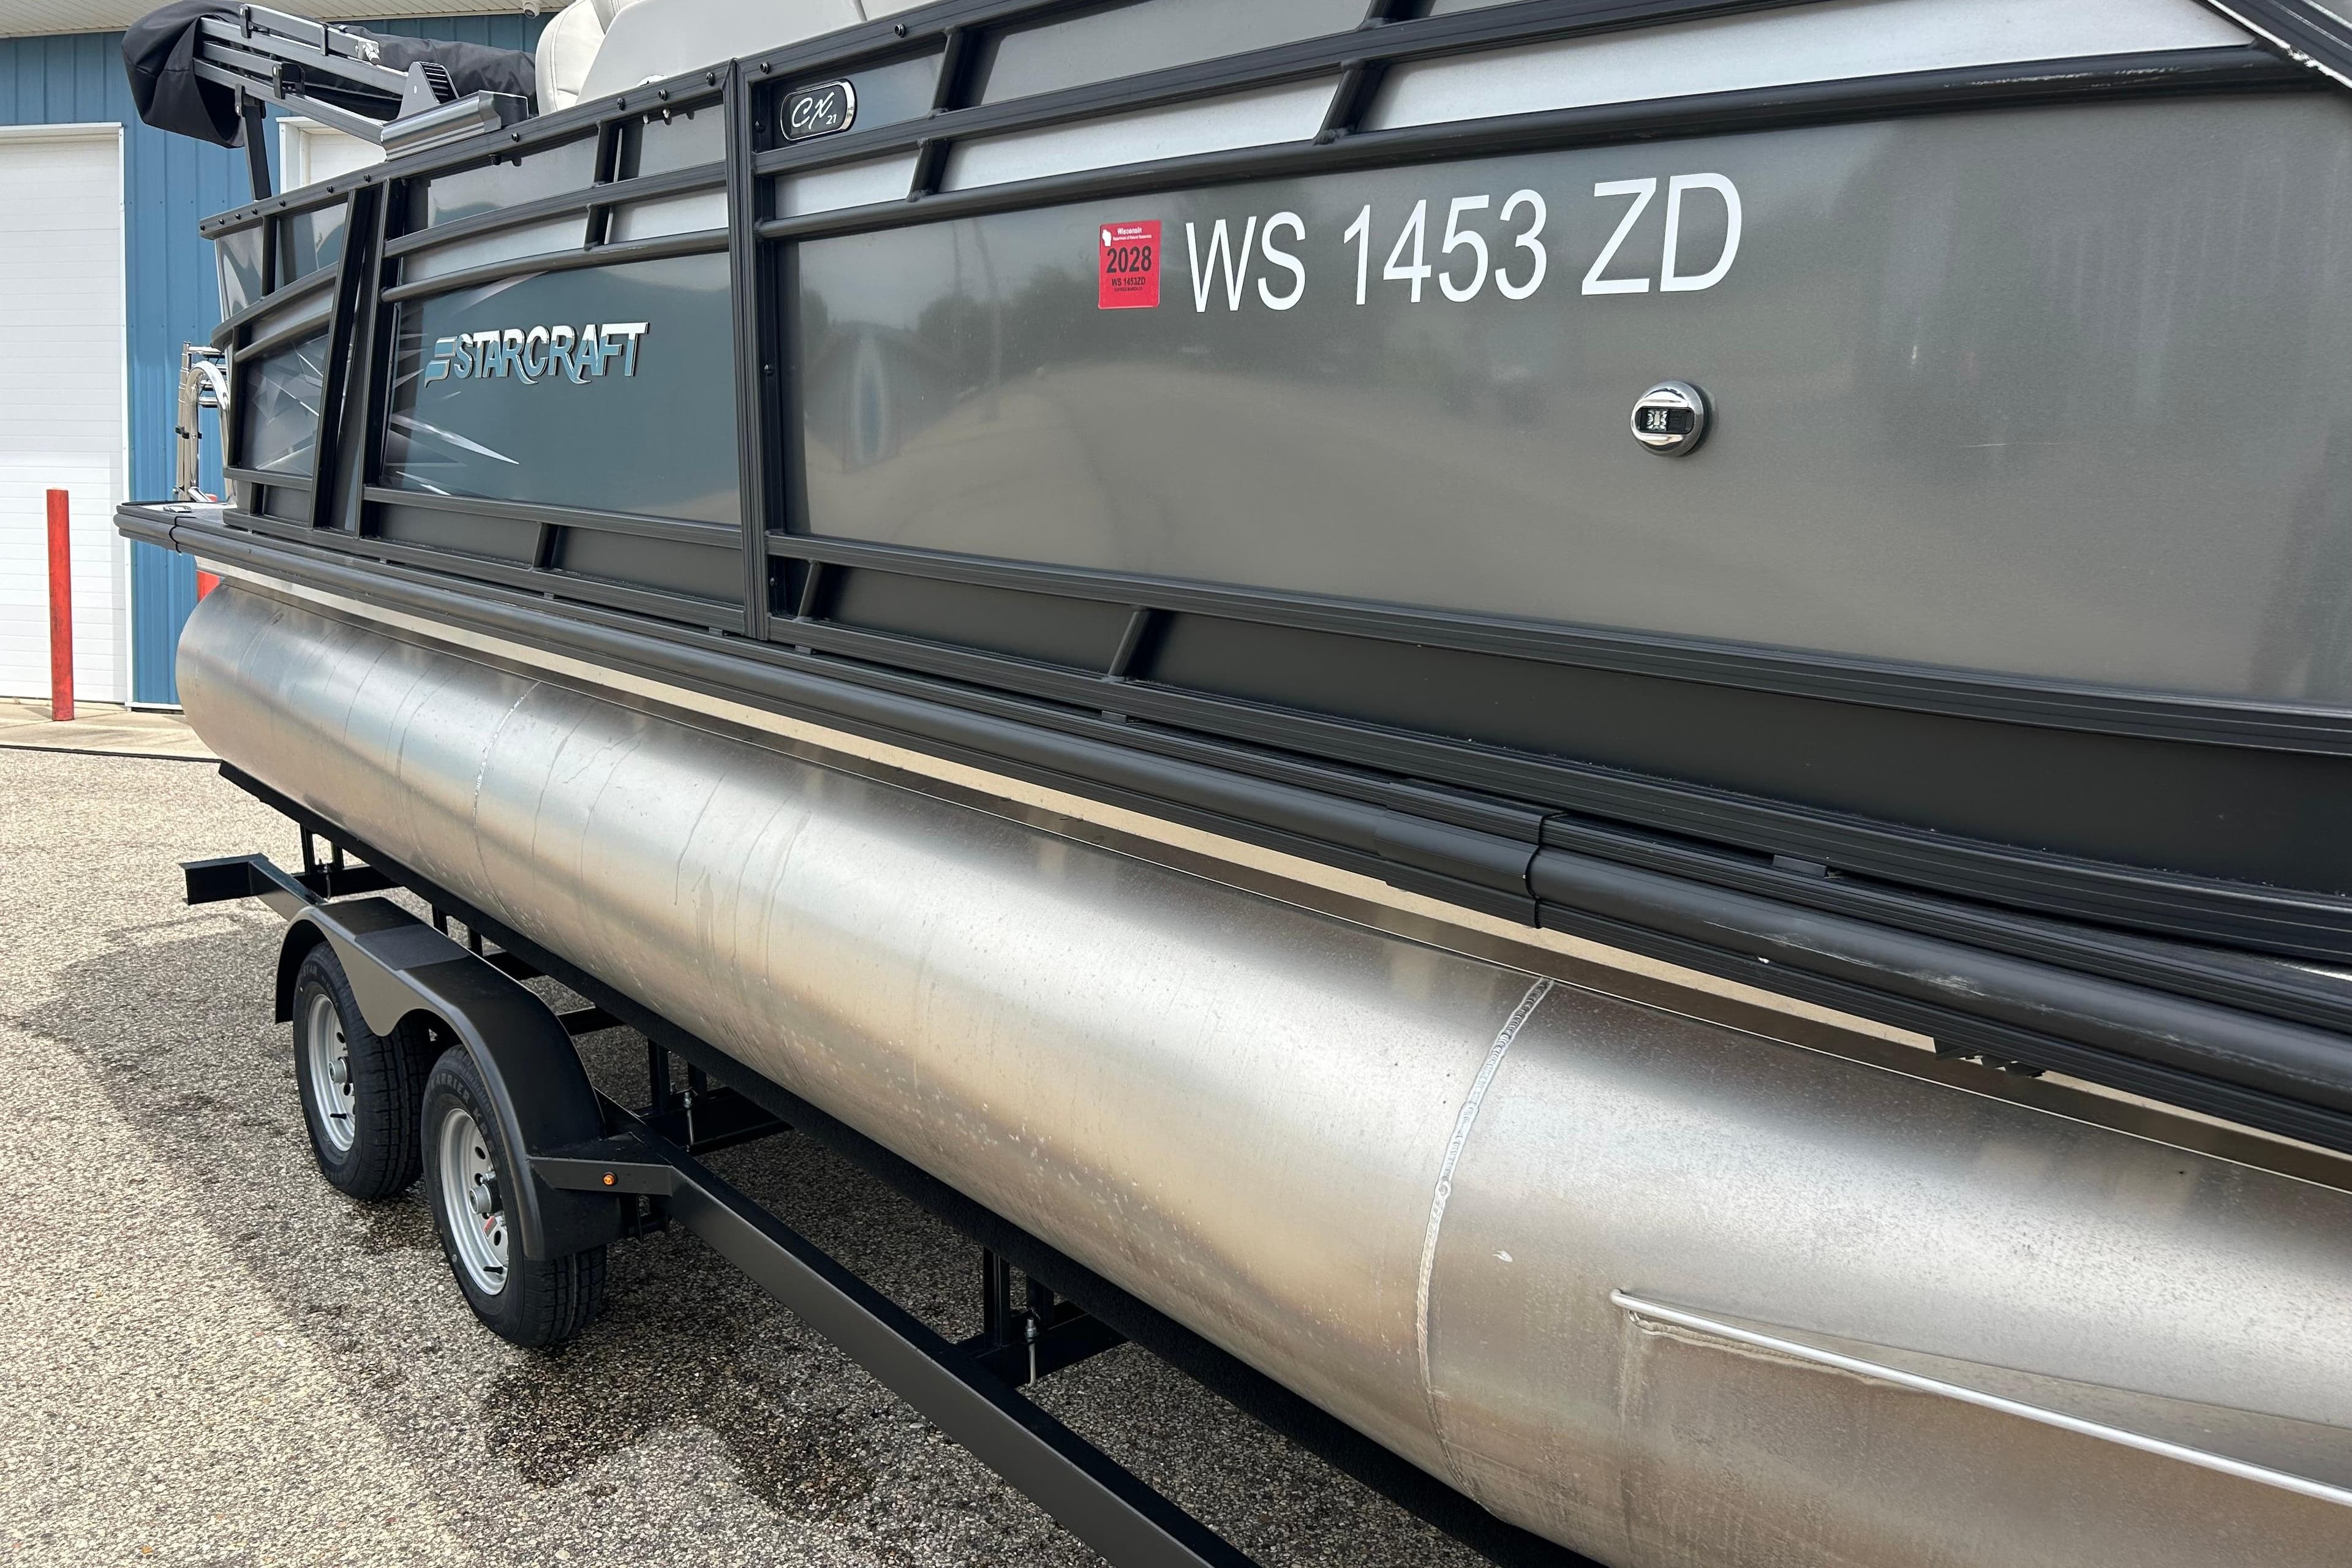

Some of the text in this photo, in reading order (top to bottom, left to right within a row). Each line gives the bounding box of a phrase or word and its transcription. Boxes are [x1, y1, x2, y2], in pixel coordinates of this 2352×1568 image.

[791, 91, 835, 130] CX
[826, 114, 838, 125] 21
[1117, 226, 1142, 235] Wisconsin
[1186, 172, 1742, 313] WS 1453 ZD
[1106, 246, 1152, 273] 2028
[1112, 276, 1146, 286] WS 1453ZD
[453, 322, 650, 385] STARCRAFT
